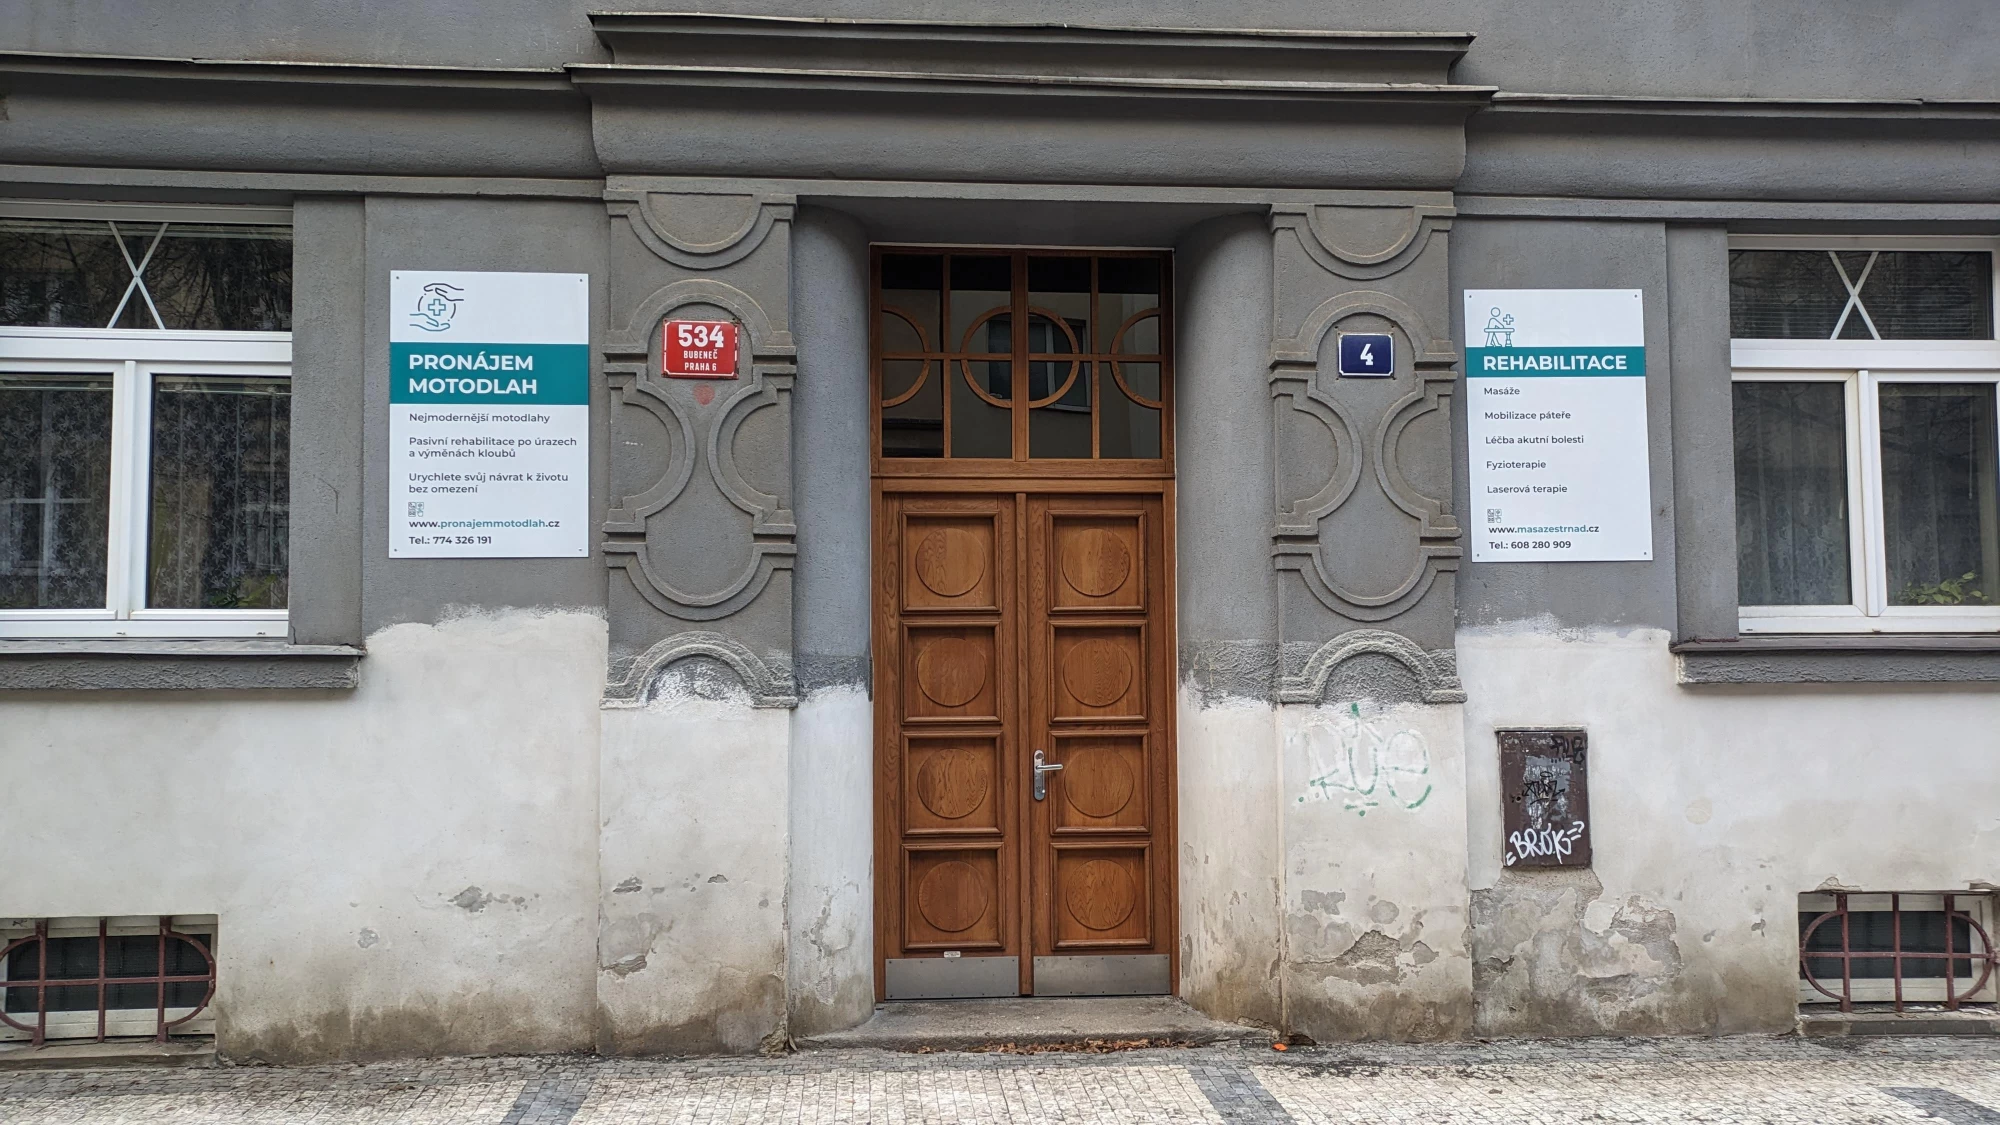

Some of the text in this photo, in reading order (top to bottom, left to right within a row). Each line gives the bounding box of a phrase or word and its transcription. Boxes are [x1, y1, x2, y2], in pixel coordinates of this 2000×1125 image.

[678, 324, 724, 347] 534
[684, 349, 718, 359] BUBENEČ
[1360, 343, 1374, 366] 4
[409, 351, 534, 371] PRONÁJEM
[1483, 355, 1627, 371] REHABILITACE
[685, 362, 717, 371] PRAHA 6
[409, 378, 537, 395] MOTODLAH
[1484, 386, 1520, 396] Masáže
[409, 413, 550, 424] Nejmodernější motodlahy
[1485, 411, 1571, 421] Mobilizace páteře
[409, 437, 577, 447] Pasivní rehabilitace po úrazech
[1485, 435, 1584, 444] Léčba akutní bolesti
[409, 448, 516, 459] a výměnách kloubů
[1486, 460, 1546, 470] Fyzioterapie
[409, 471, 568, 483] Urychlete svůj návrat k životu
[409, 485, 478, 493] bez omezení
[1487, 485, 1568, 494] Laserová terapie
[409, 519, 560, 529] www.pronajemmotodlah.cz
[1489, 525, 1599, 534] www.masazestrnad.cz
[409, 536, 492, 545] Tel.: 774 326 191
[1489, 541, 1571, 549] Tel.: 608 280 909
